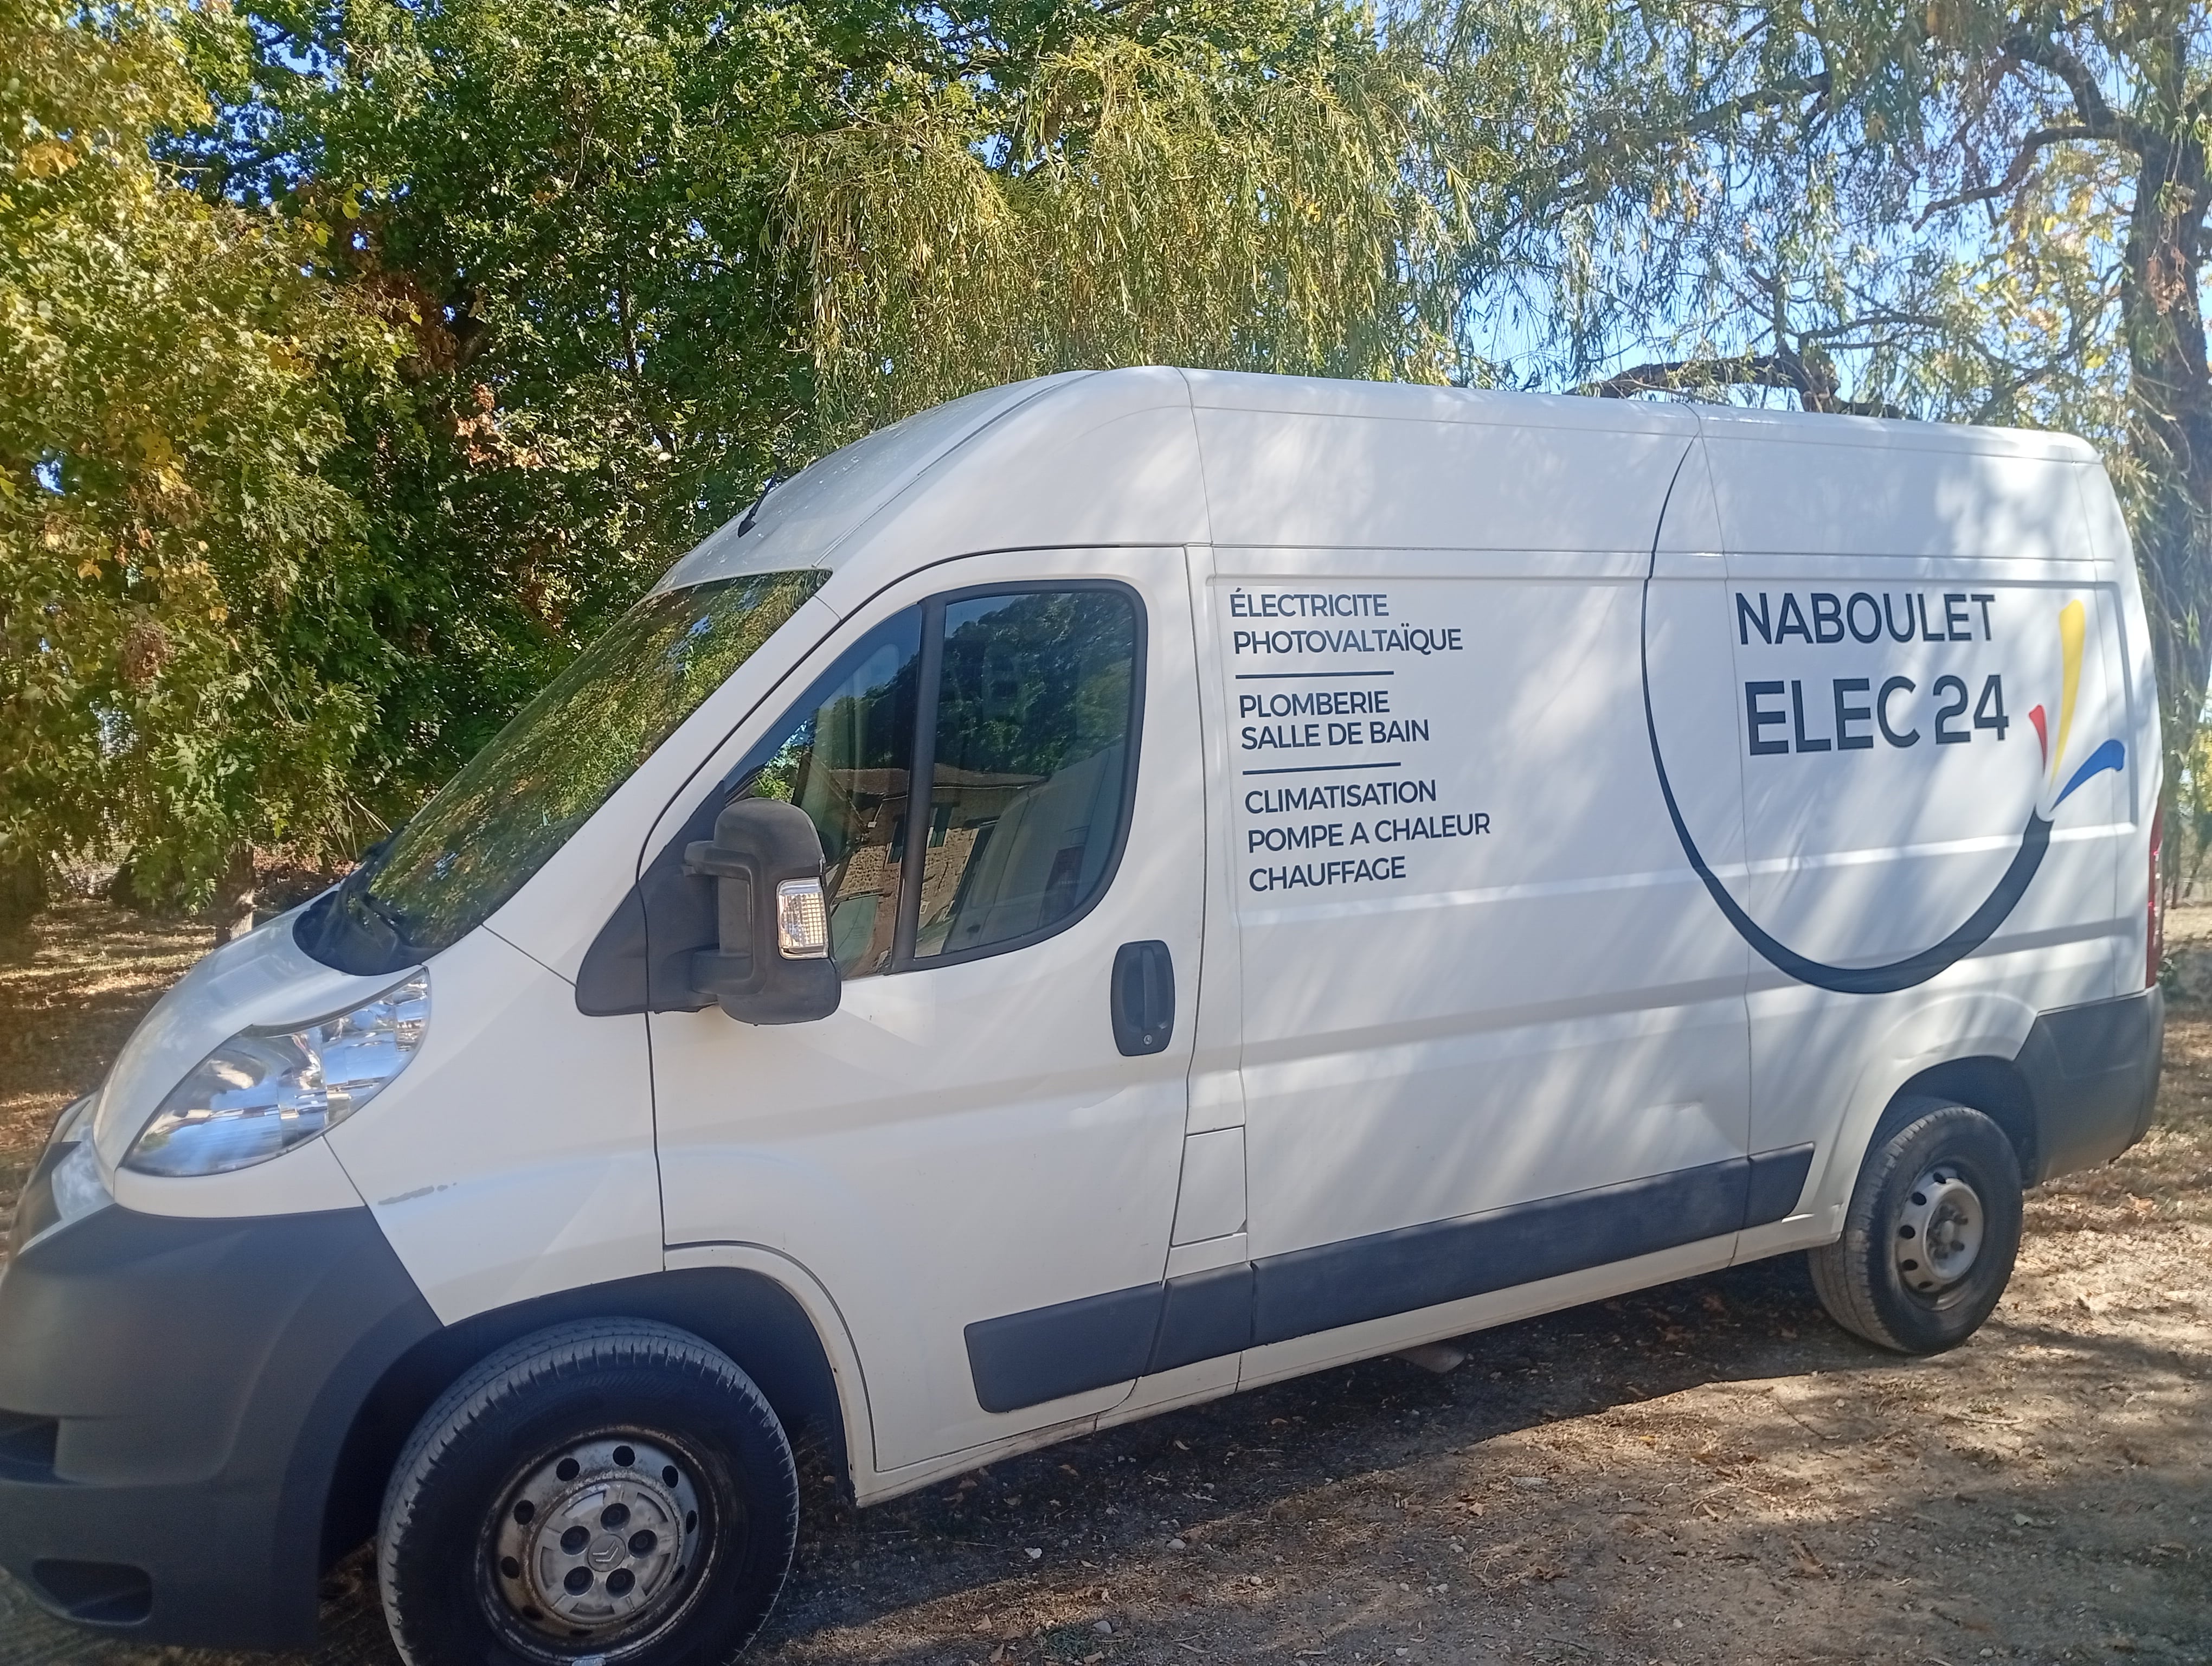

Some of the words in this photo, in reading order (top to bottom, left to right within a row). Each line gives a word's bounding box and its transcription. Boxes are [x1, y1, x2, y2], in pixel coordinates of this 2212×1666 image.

[1230, 587, 1389, 617] ÉLECTRICITE
[1735, 592, 1996, 645] NABOULET
[1233, 623, 1463, 656] PHOTOVALTAÏQUE
[1239, 690, 1391, 719] PLOMBERIE
[1744, 676, 1921, 757] ELEC
[1932, 674, 2010, 746] 24
[1242, 723, 1321, 750] SALLE
[1327, 722, 1364, 746] DE
[1369, 719, 1430, 744] BAIN
[1245, 779, 1437, 815] CLIMATISATION
[1248, 823, 1344, 854] POMPE
[1349, 822, 1370, 845] A
[1374, 812, 1490, 843] CHALEUR
[1249, 855, 1407, 892] CHAUFFAGE
